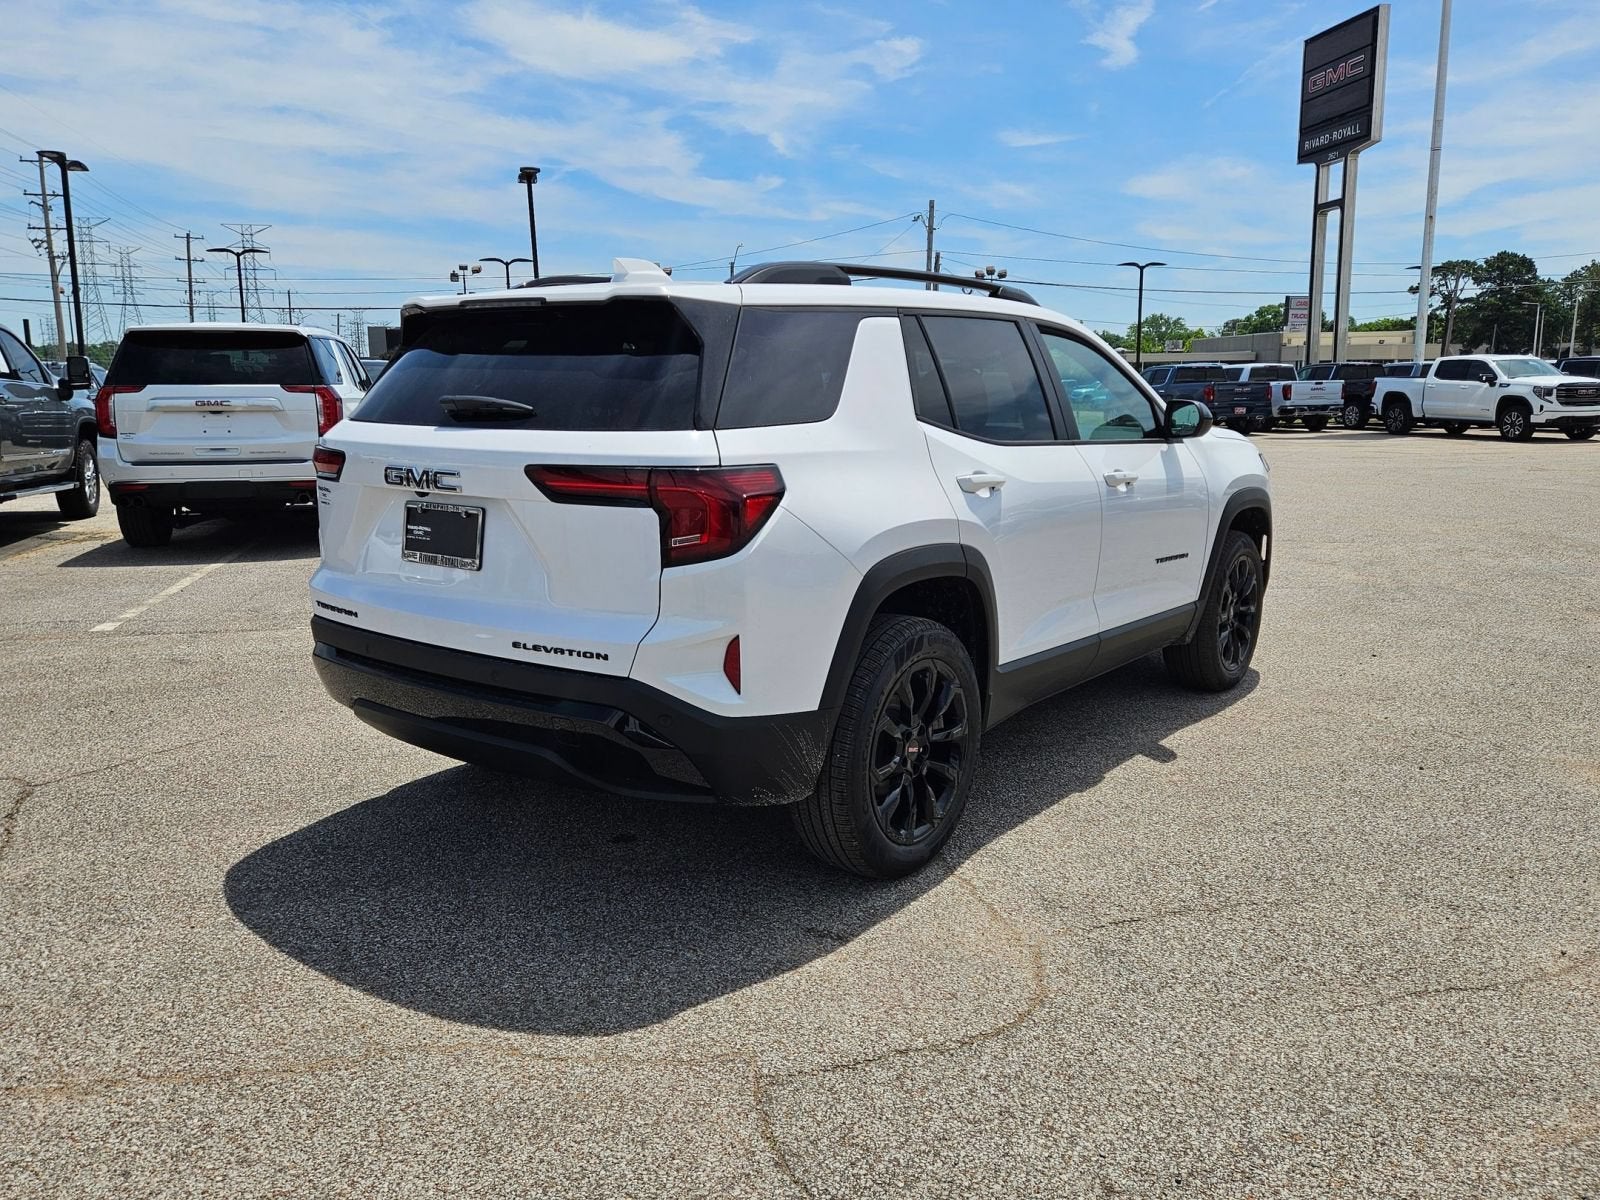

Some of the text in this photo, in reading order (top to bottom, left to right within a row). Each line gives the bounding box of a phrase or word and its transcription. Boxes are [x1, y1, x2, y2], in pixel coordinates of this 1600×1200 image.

[1308, 54, 1365, 93] GMC
[1304, 122, 1361, 150] RIVARD-ROYALL
[384, 465, 462, 493] GMC
[1155, 553, 1189, 564] TERRAIN
[315, 600, 358, 618] TERRAIN
[511, 641, 609, 661] ELEVATION
